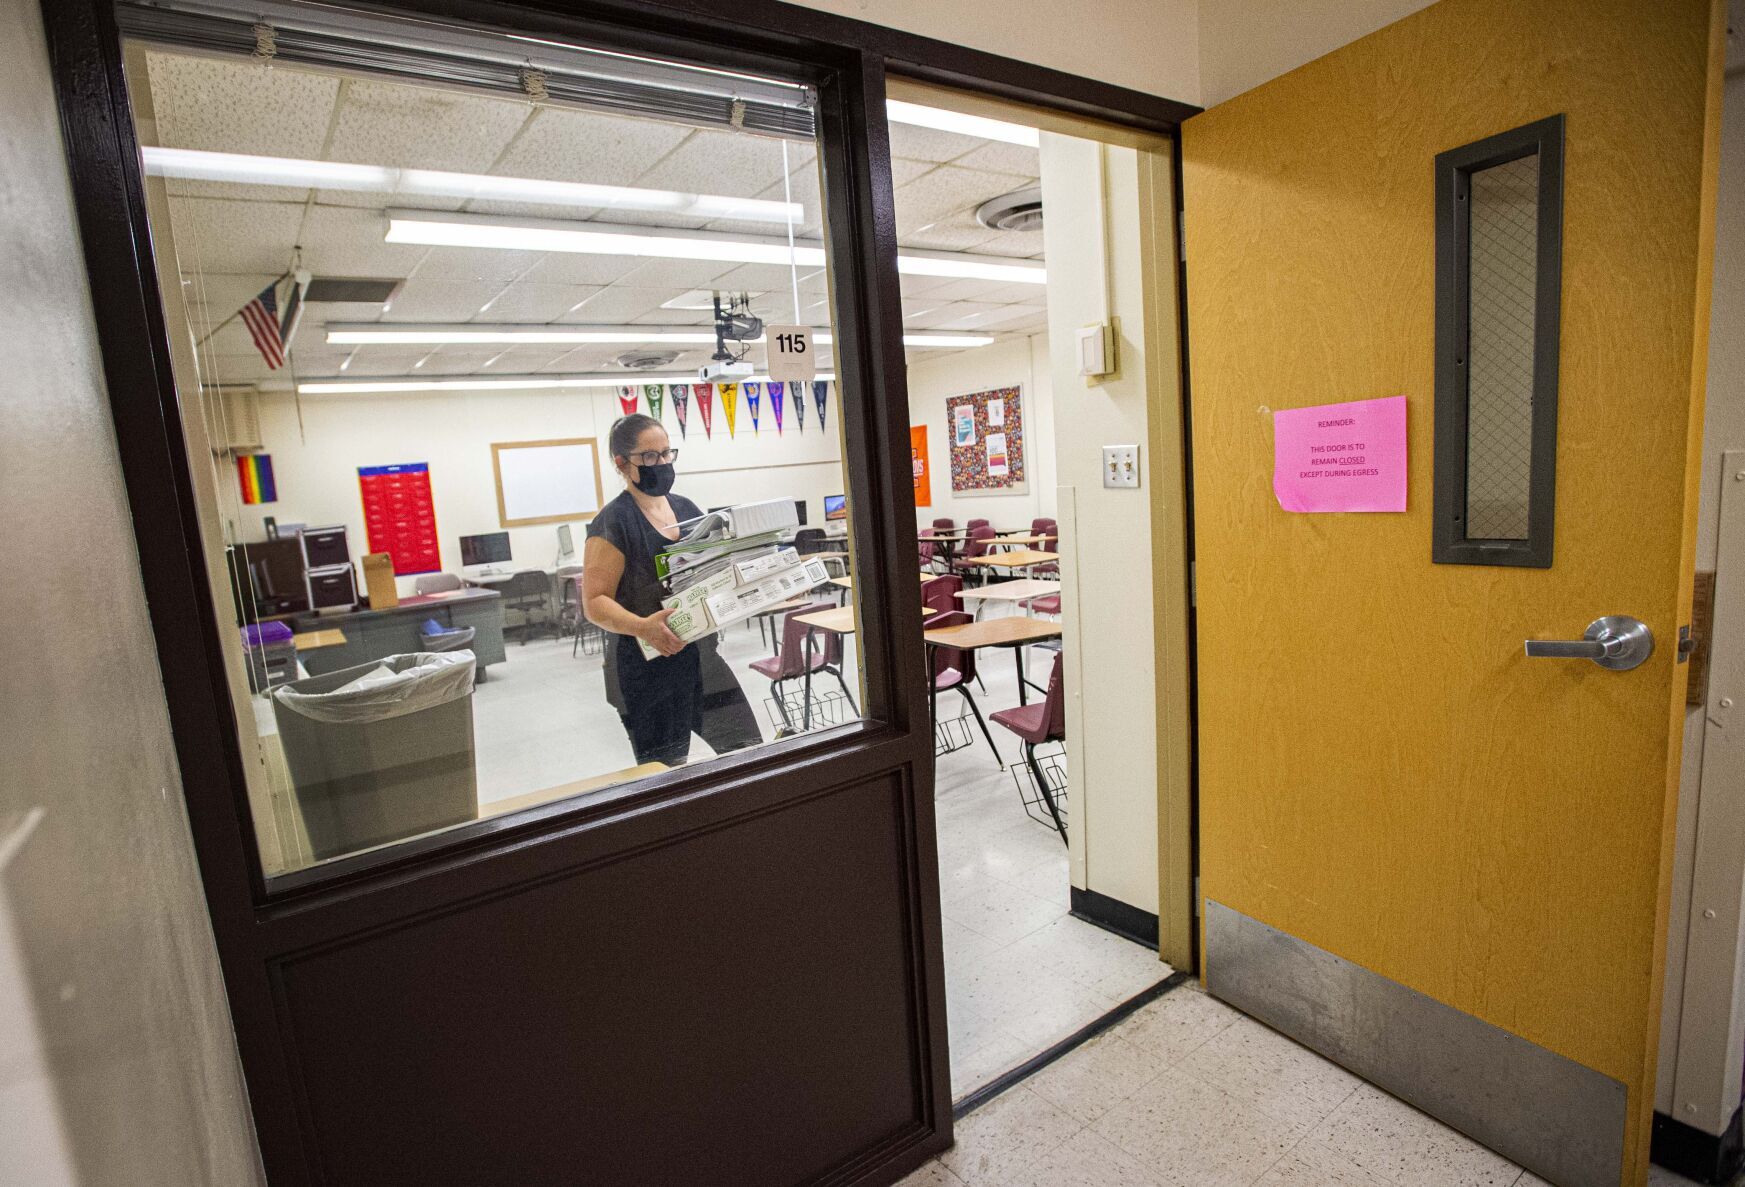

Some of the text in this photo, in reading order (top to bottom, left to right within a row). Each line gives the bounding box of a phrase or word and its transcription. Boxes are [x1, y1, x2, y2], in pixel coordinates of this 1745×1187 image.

[776, 334, 805, 353] 115
[1318, 418, 1356, 428] REMINDER:
[1339, 456, 1366, 465] CLOSED
[1300, 470, 1323, 478] EXCEPT
[1353, 468, 1379, 476] EGRESS
